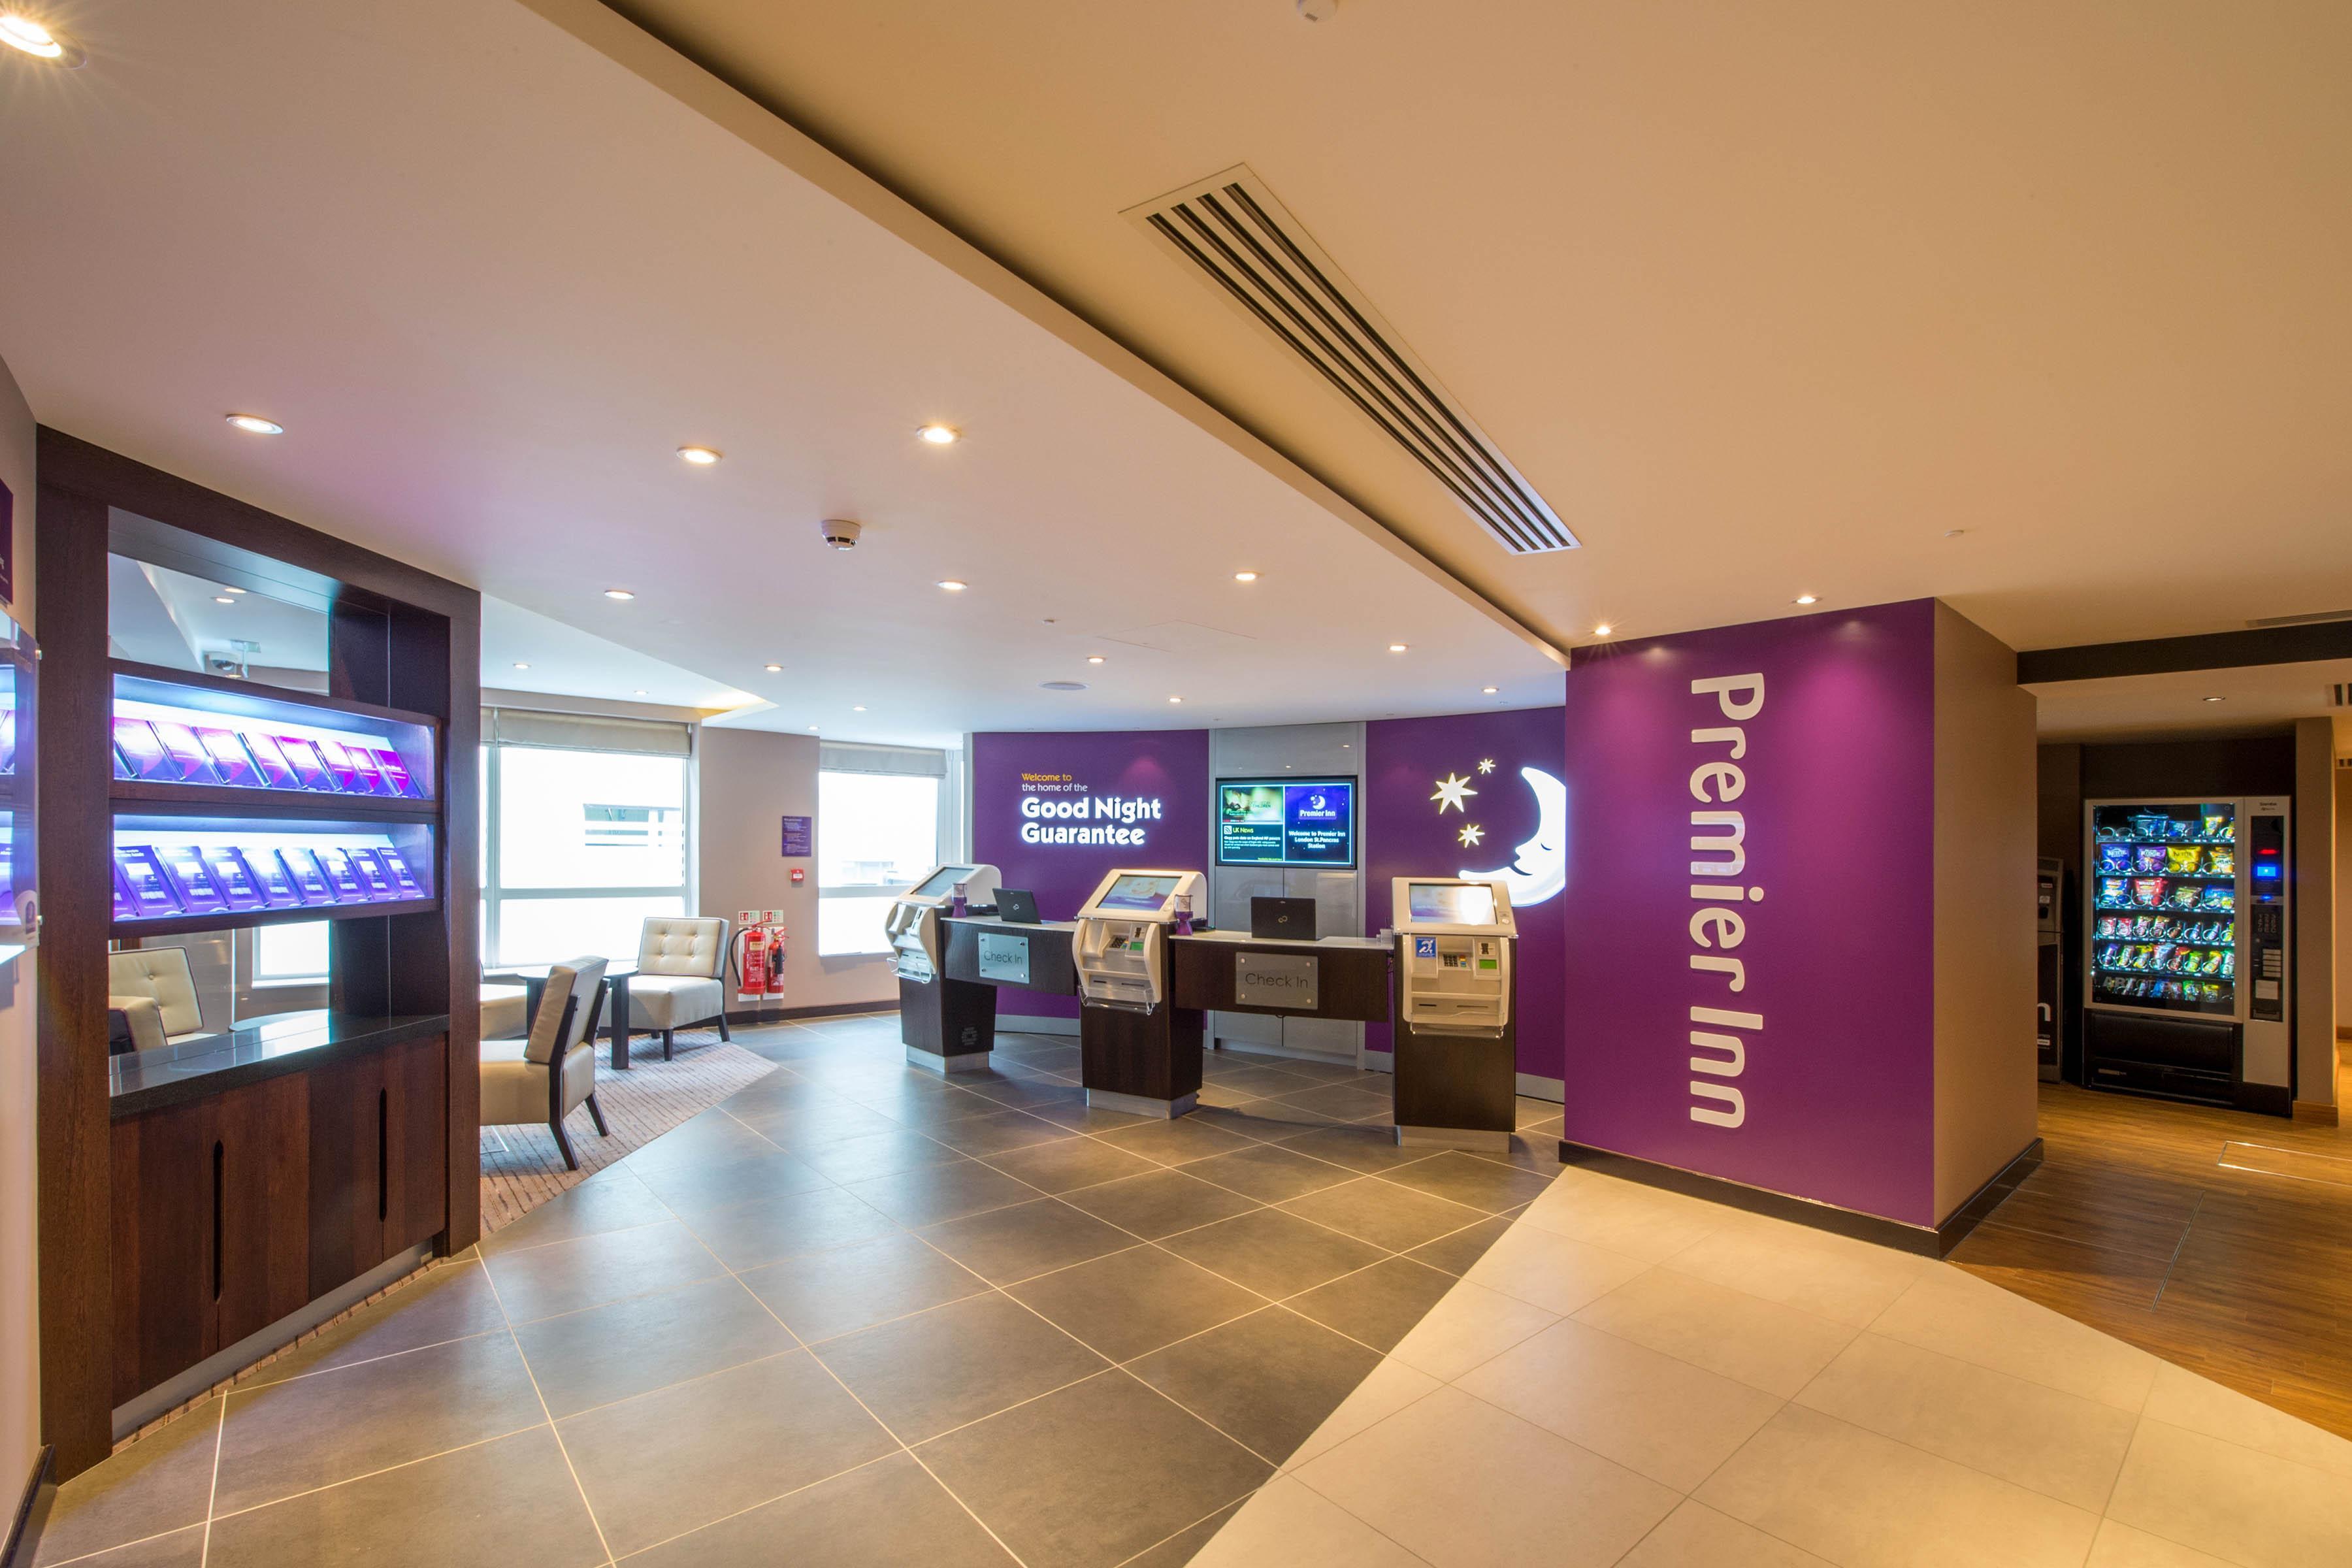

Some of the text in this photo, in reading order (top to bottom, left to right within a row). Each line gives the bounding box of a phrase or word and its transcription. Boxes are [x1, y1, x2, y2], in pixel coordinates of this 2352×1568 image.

[1021, 773, 1060, 781] Welcome
[1022, 783, 1088, 792] the home of the
[1021, 796, 1162, 823] Good Night
[1021, 822, 1145, 845] Guarantee
[1689, 672, 1765, 1129] Premier Inn
[984, 950, 1022, 965] Check In
[1245, 972, 1309, 988] Check In
